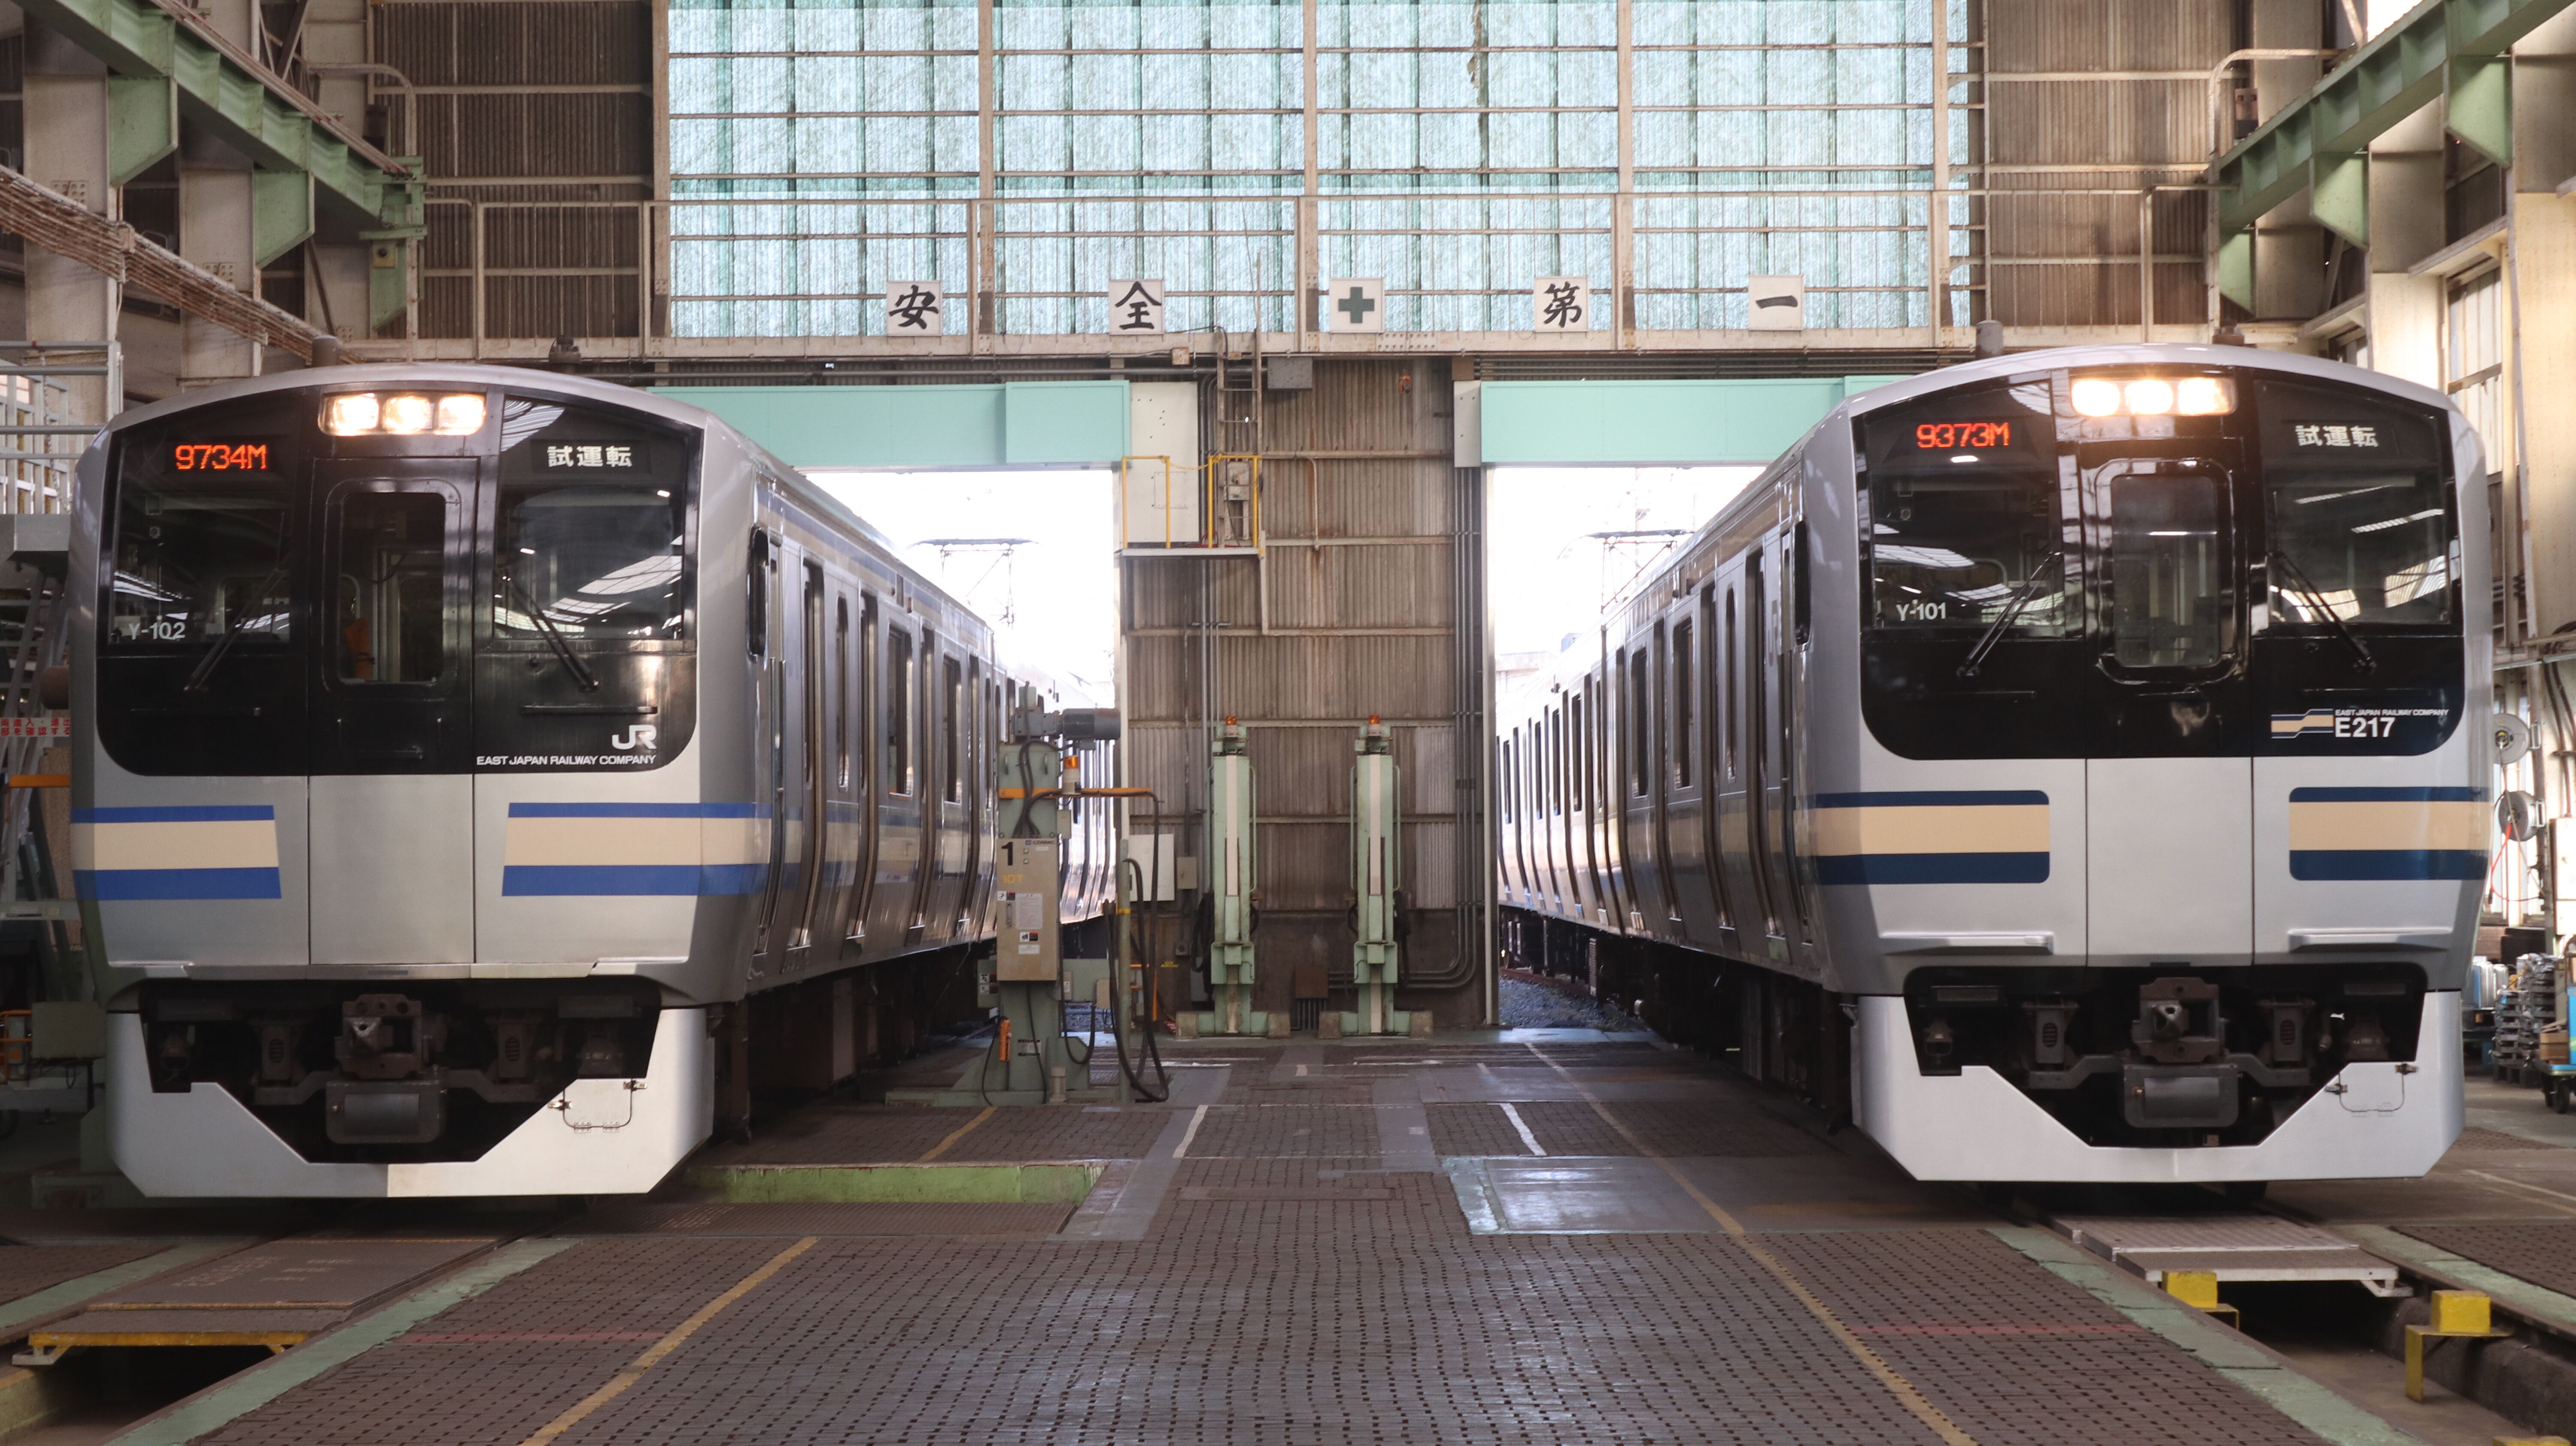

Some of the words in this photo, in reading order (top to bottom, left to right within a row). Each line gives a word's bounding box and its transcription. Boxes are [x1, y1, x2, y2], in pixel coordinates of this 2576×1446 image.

[889, 285, 939, 329] 安
[1115, 281, 1162, 330] 全
[1543, 283, 1582, 328] 第
[1756, 295, 1798, 309] 一
[1916, 422, 2010, 448] 9373M
[2295, 425, 2379, 447] 試運転
[175, 444, 268, 470] 9734M
[547, 445, 632, 468] 試運転
[1896, 601, 1946, 622] Y-101
[129, 621, 186, 640] Y-102
[612, 724, 657, 750] JR
[2335, 717, 2395, 738] E217
[477, 755, 508, 766] EAST
[509, 755, 548, 765] JAPAN
[550, 755, 598, 765] RAILWAY
[599, 754, 656, 765] COMPANY
[1001, 841, 1013, 866] 1
